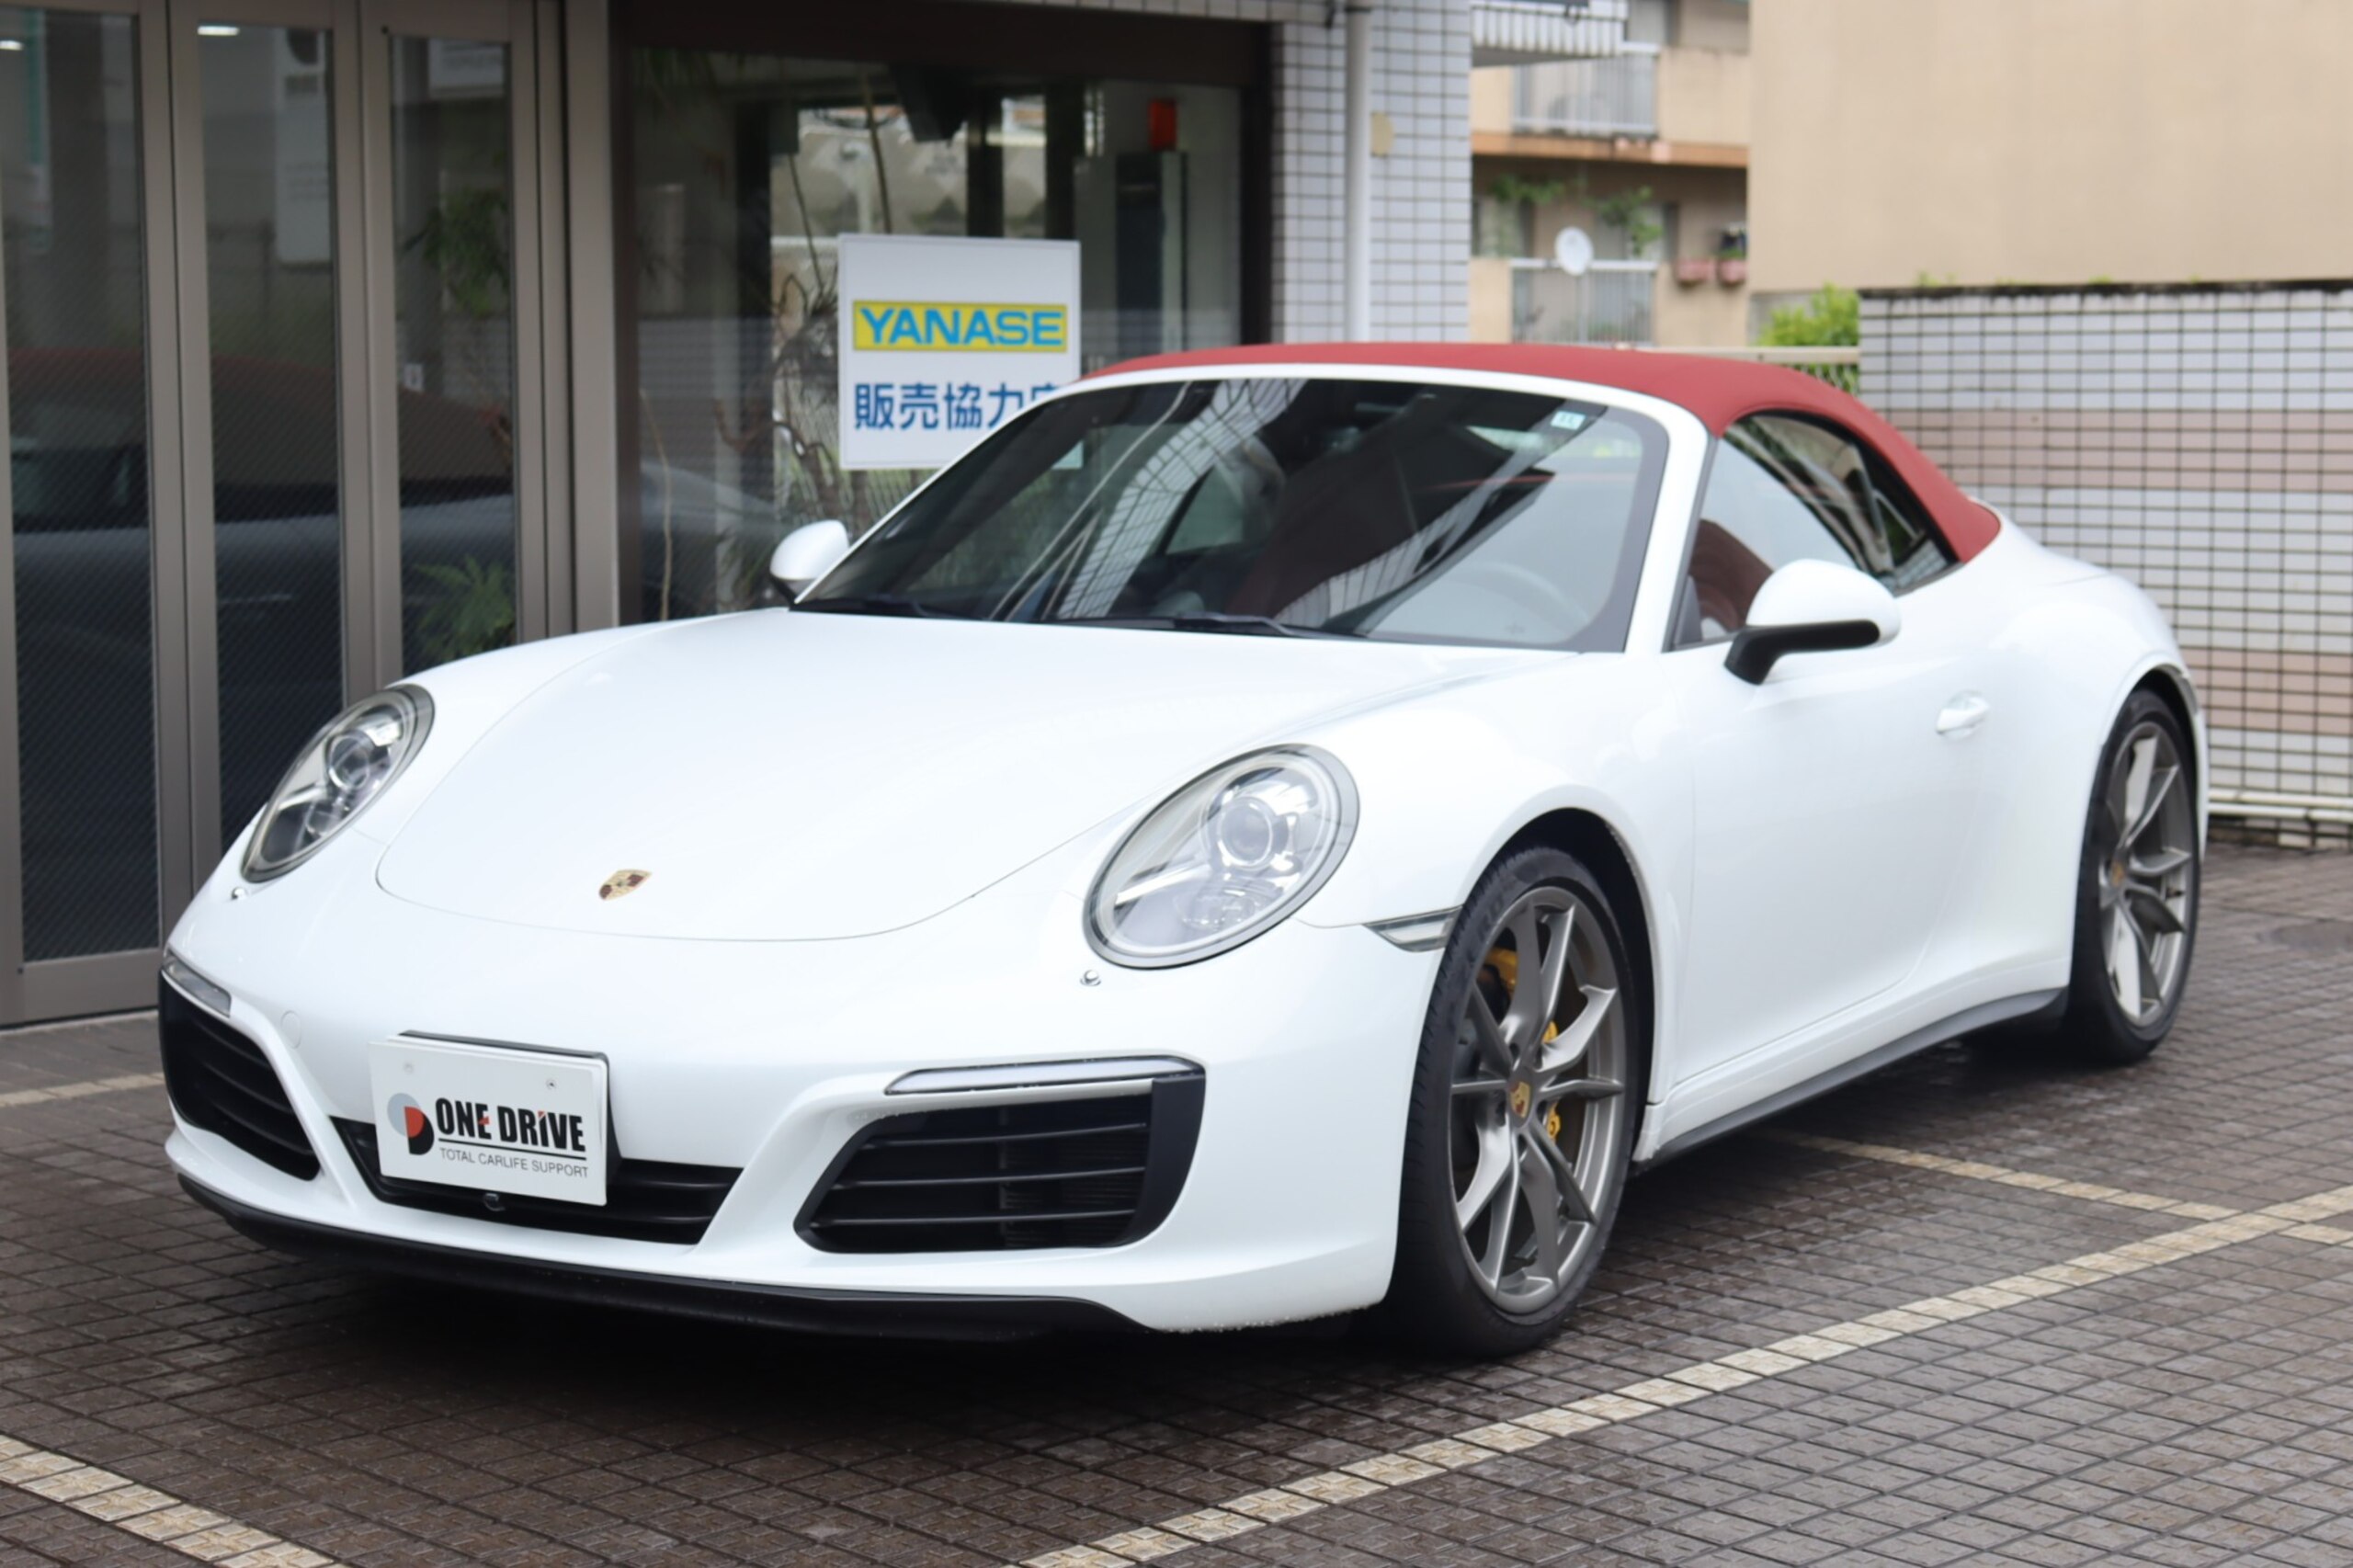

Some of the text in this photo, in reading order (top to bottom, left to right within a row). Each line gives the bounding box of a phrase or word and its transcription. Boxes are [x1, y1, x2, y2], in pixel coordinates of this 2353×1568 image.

[859, 308, 1064, 347] YANASE
[855, 382, 1059, 430] 販売協力
[435, 1097, 492, 1140] ONE
[439, 1146, 589, 1178] TOTAL CARLIFE SUPPORT
